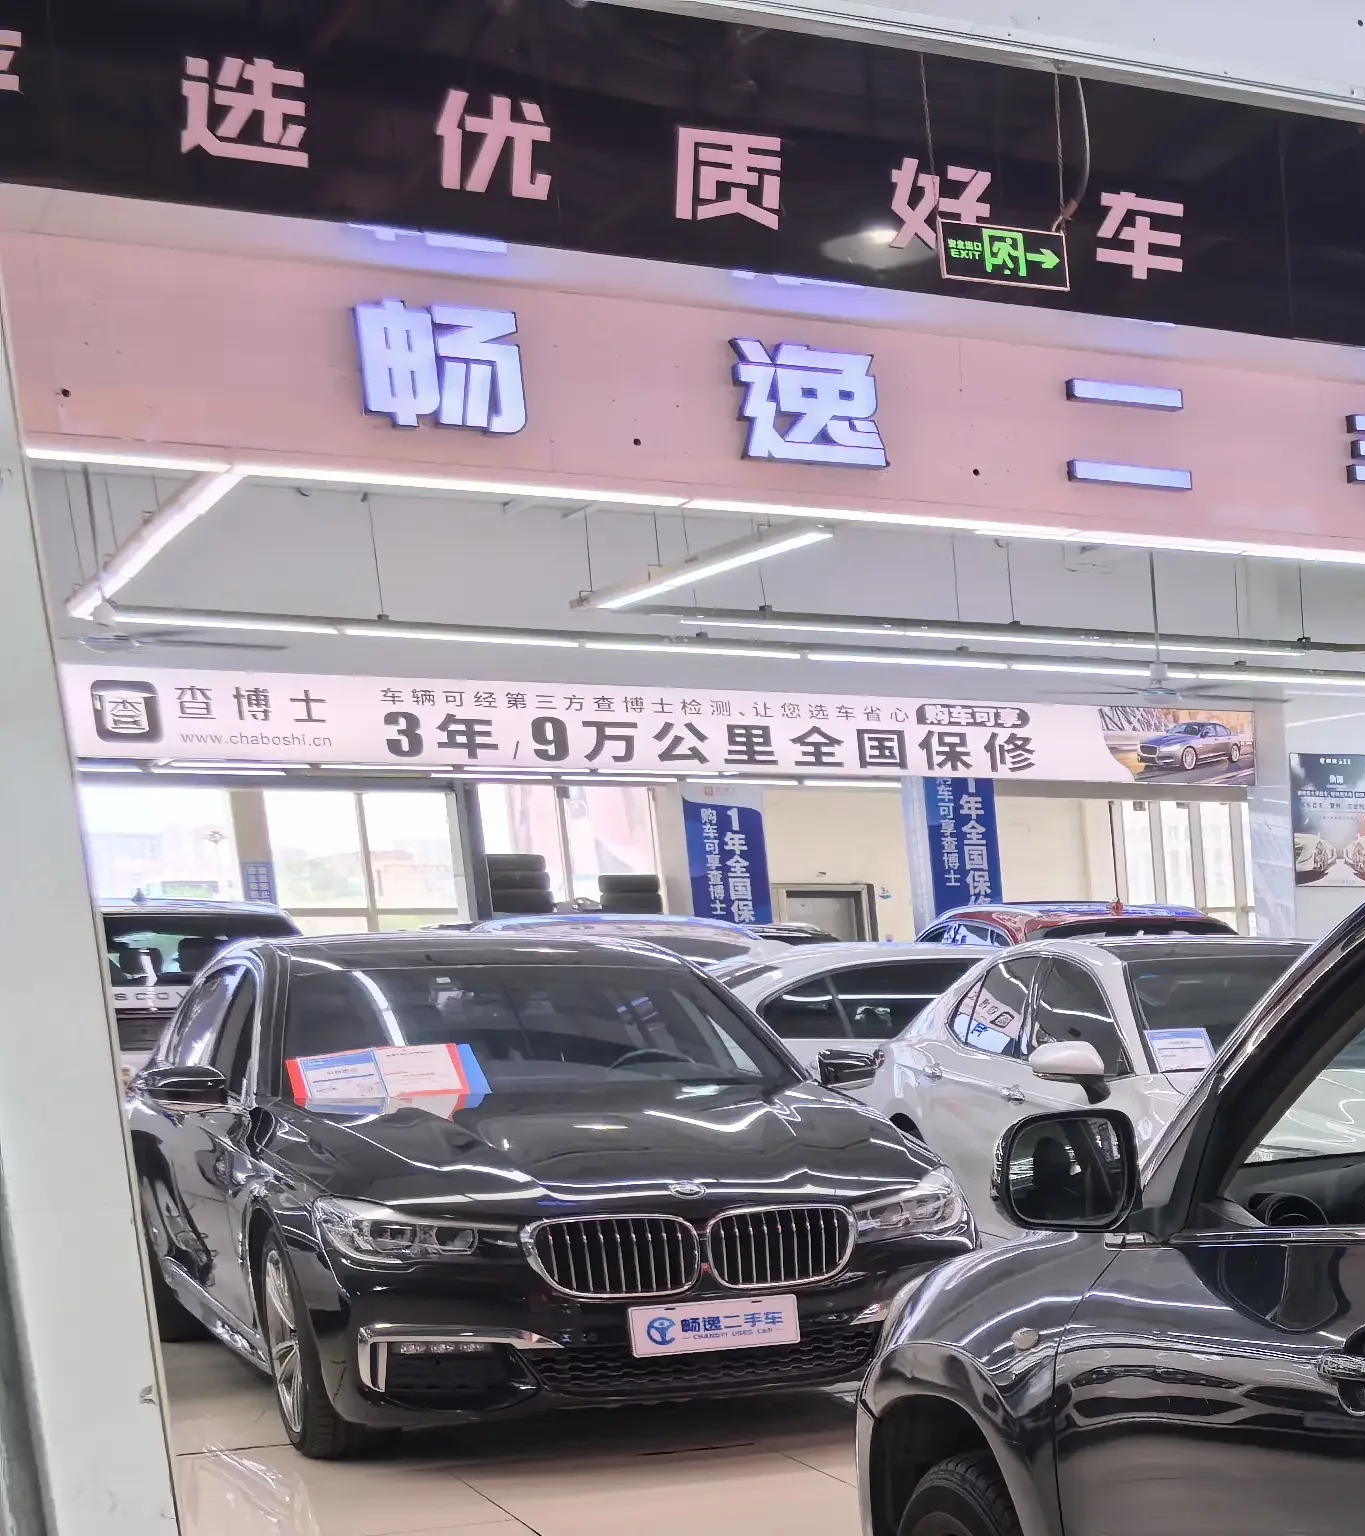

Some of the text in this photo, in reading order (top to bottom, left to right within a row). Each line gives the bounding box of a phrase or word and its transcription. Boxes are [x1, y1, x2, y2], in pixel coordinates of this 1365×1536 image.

[0, 30, 1184, 281] 选优质好车
[950, 250, 982, 260] EXIT
[173, 684, 327, 723] 查博士
[925, 704, 1022, 728] 购车可享
[180, 731, 333, 748] www.chaboshi.cn
[700, 808, 727, 915] 购车可享查博士
[680, 1311, 784, 1333] 畅逸二手车
